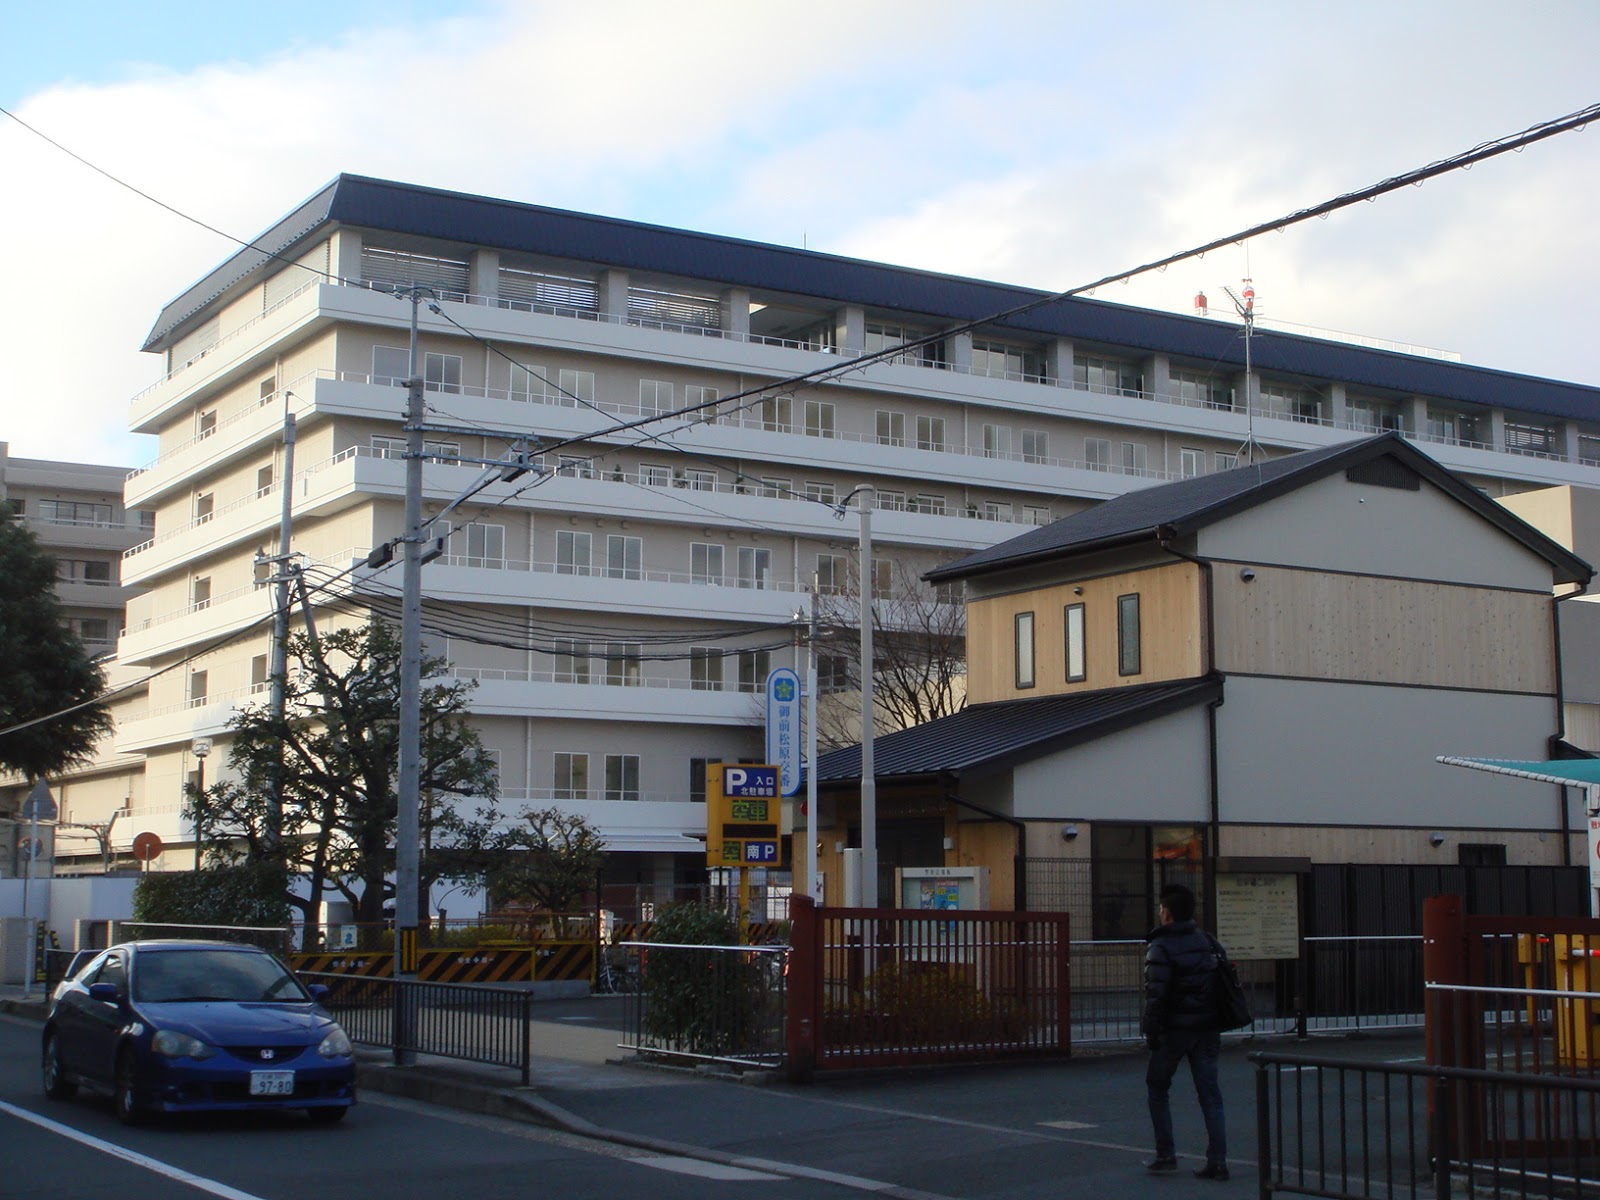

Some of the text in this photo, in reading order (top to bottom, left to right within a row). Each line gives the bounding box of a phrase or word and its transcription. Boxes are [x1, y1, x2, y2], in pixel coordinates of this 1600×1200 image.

[779, 705, 790, 787] 御前松原交番
[726, 768, 748, 795] P
[756, 776, 774, 786] 入口
[764, 845, 775, 859] P
[259, 1081, 292, 1093] 97-80
